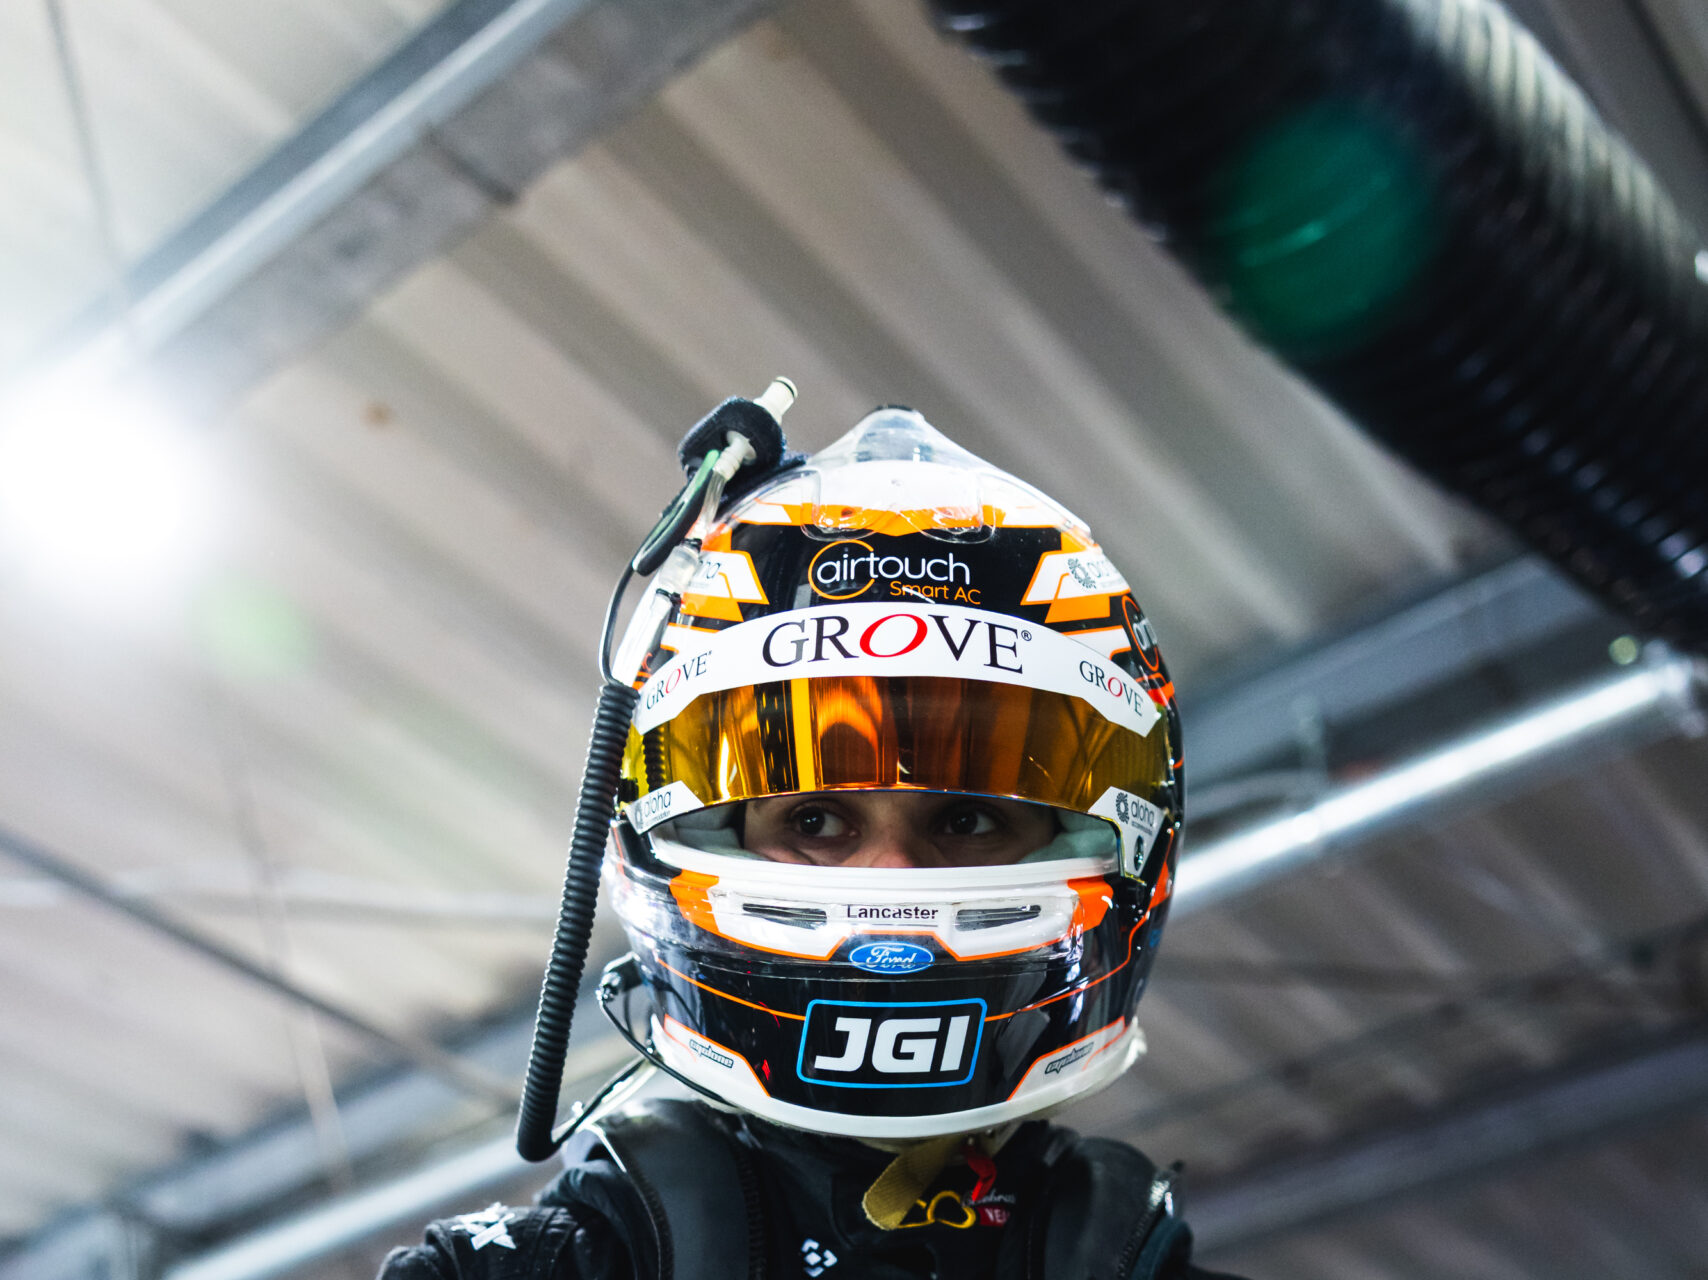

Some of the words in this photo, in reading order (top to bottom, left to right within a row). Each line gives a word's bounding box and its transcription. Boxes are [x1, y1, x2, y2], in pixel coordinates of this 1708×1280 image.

[817, 552, 970, 585] airtouch
[890, 580, 949, 600] Smart
[954, 585, 981, 604] AC
[1079, 660, 1144, 717] GROVE
[847, 905, 938, 919] Lancaster
[866, 946, 918, 968] Ford
[814, 1015, 970, 1074] JGI
